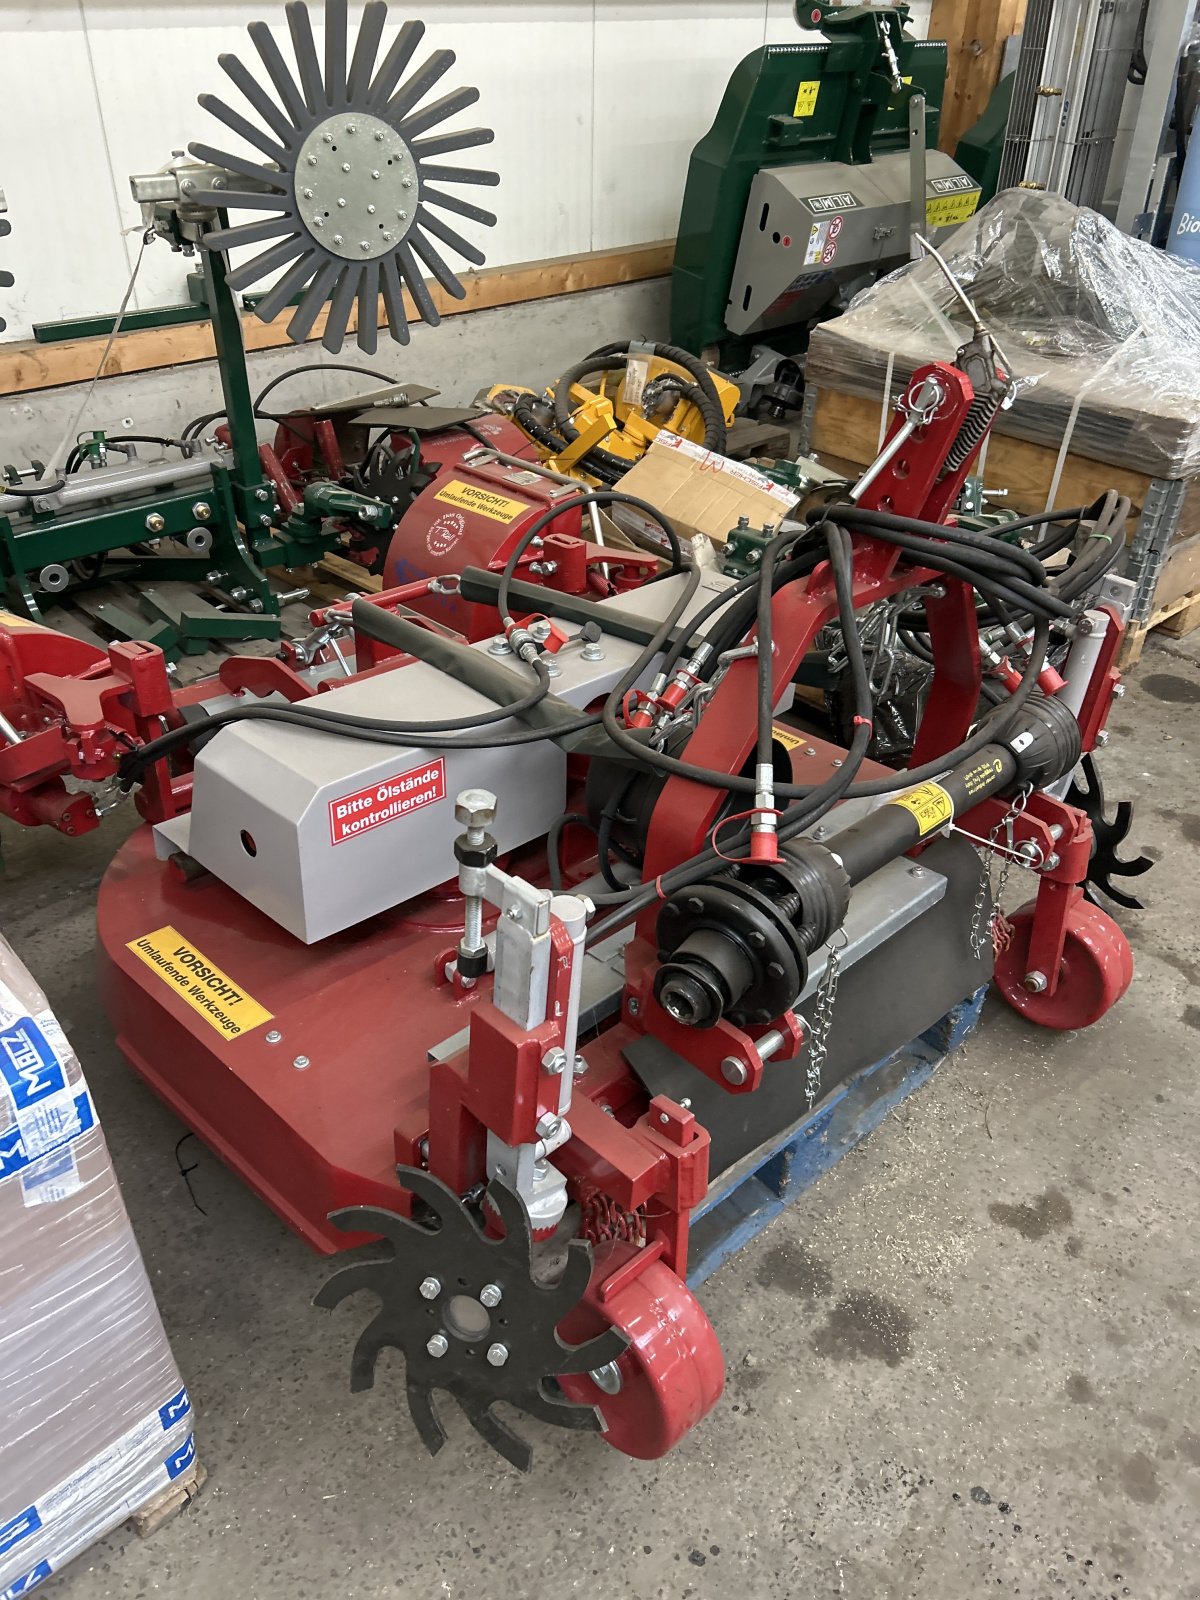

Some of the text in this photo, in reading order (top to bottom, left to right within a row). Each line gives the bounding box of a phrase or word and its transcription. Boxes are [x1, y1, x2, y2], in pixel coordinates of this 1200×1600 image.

[1176, 212, 1200, 235] Bio
[439, 490, 514, 521] Umlaufende Werkzeuge
[461, 487, 510, 508] VORSICHT!
[336, 768, 439, 820] Bitte Ölstände
[341, 785, 437, 836] kontrollieren!
[136, 939, 241, 1035] Umlaufende Werkzeuge
[172, 945, 243, 1007] VORSICHT!
[1, 1027, 52, 1097] MALZ
